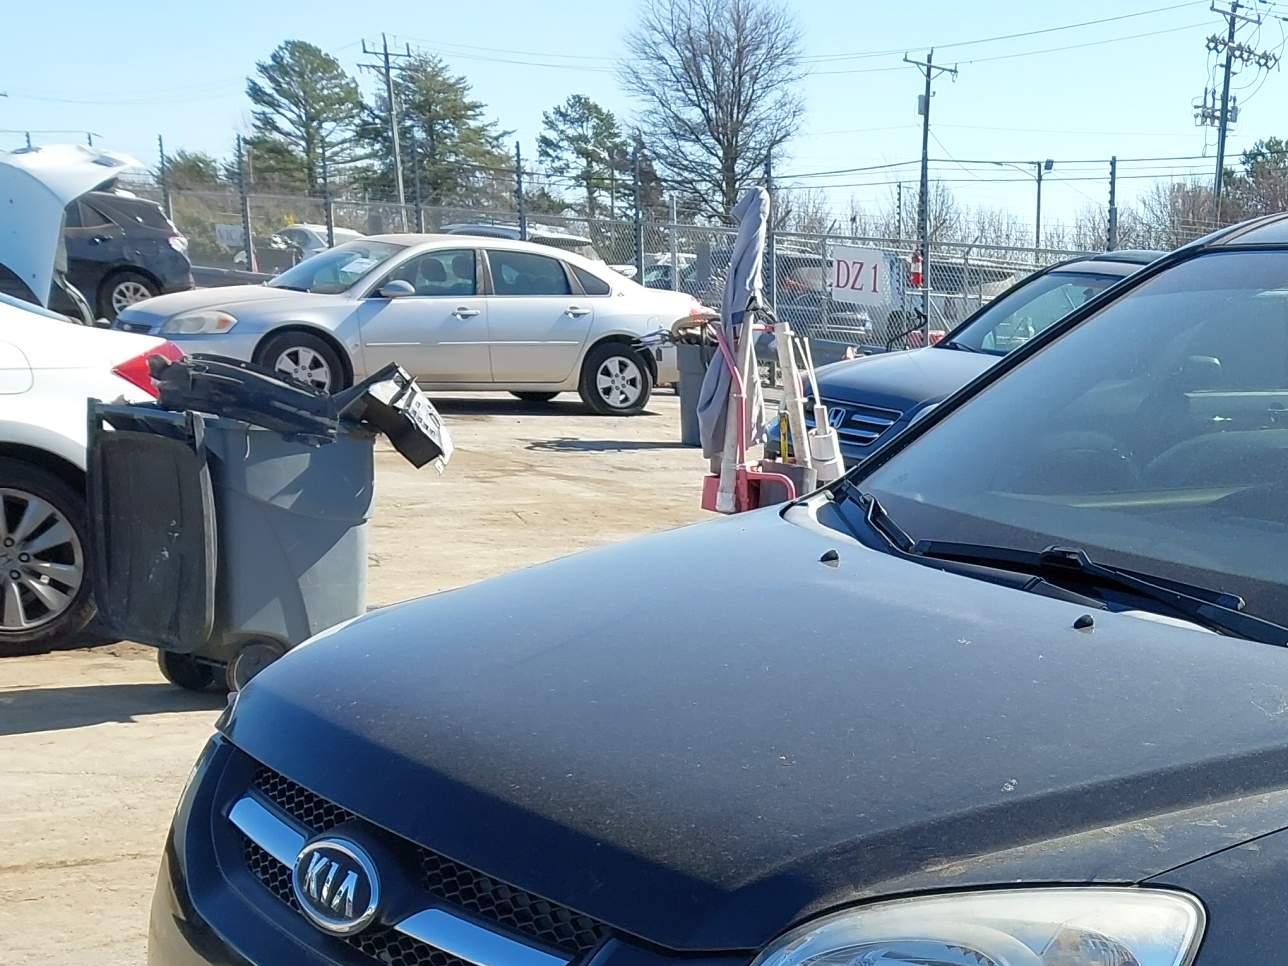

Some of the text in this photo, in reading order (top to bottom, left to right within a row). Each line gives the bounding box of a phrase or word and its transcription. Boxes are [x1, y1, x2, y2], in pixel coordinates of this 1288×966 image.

[835, 259, 880, 294] DZ 1
[303, 851, 358, 918] KIA
